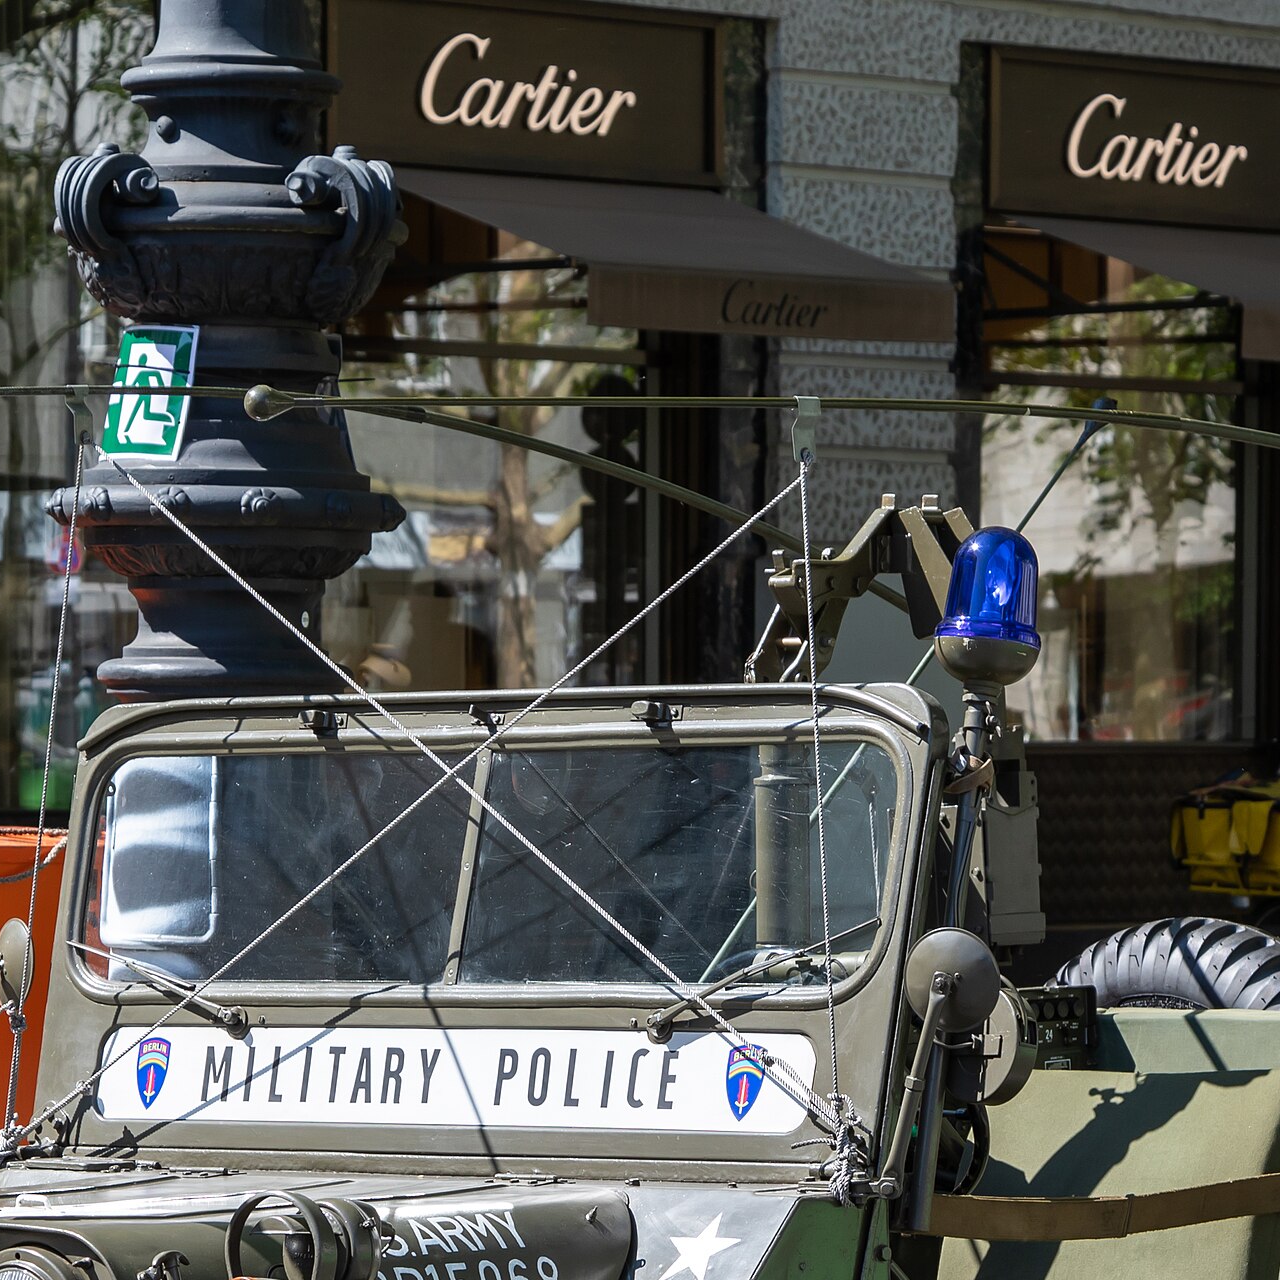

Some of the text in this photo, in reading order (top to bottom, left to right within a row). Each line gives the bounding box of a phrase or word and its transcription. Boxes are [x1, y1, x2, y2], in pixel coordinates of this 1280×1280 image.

[421, 33, 637, 137] Cartier
[1067, 93, 1248, 189] Cartier
[721, 279, 828, 328] Cartier
[142, 1042, 168, 1054] BERLIN
[200, 1045, 680, 1110] MILITARY POLICE
